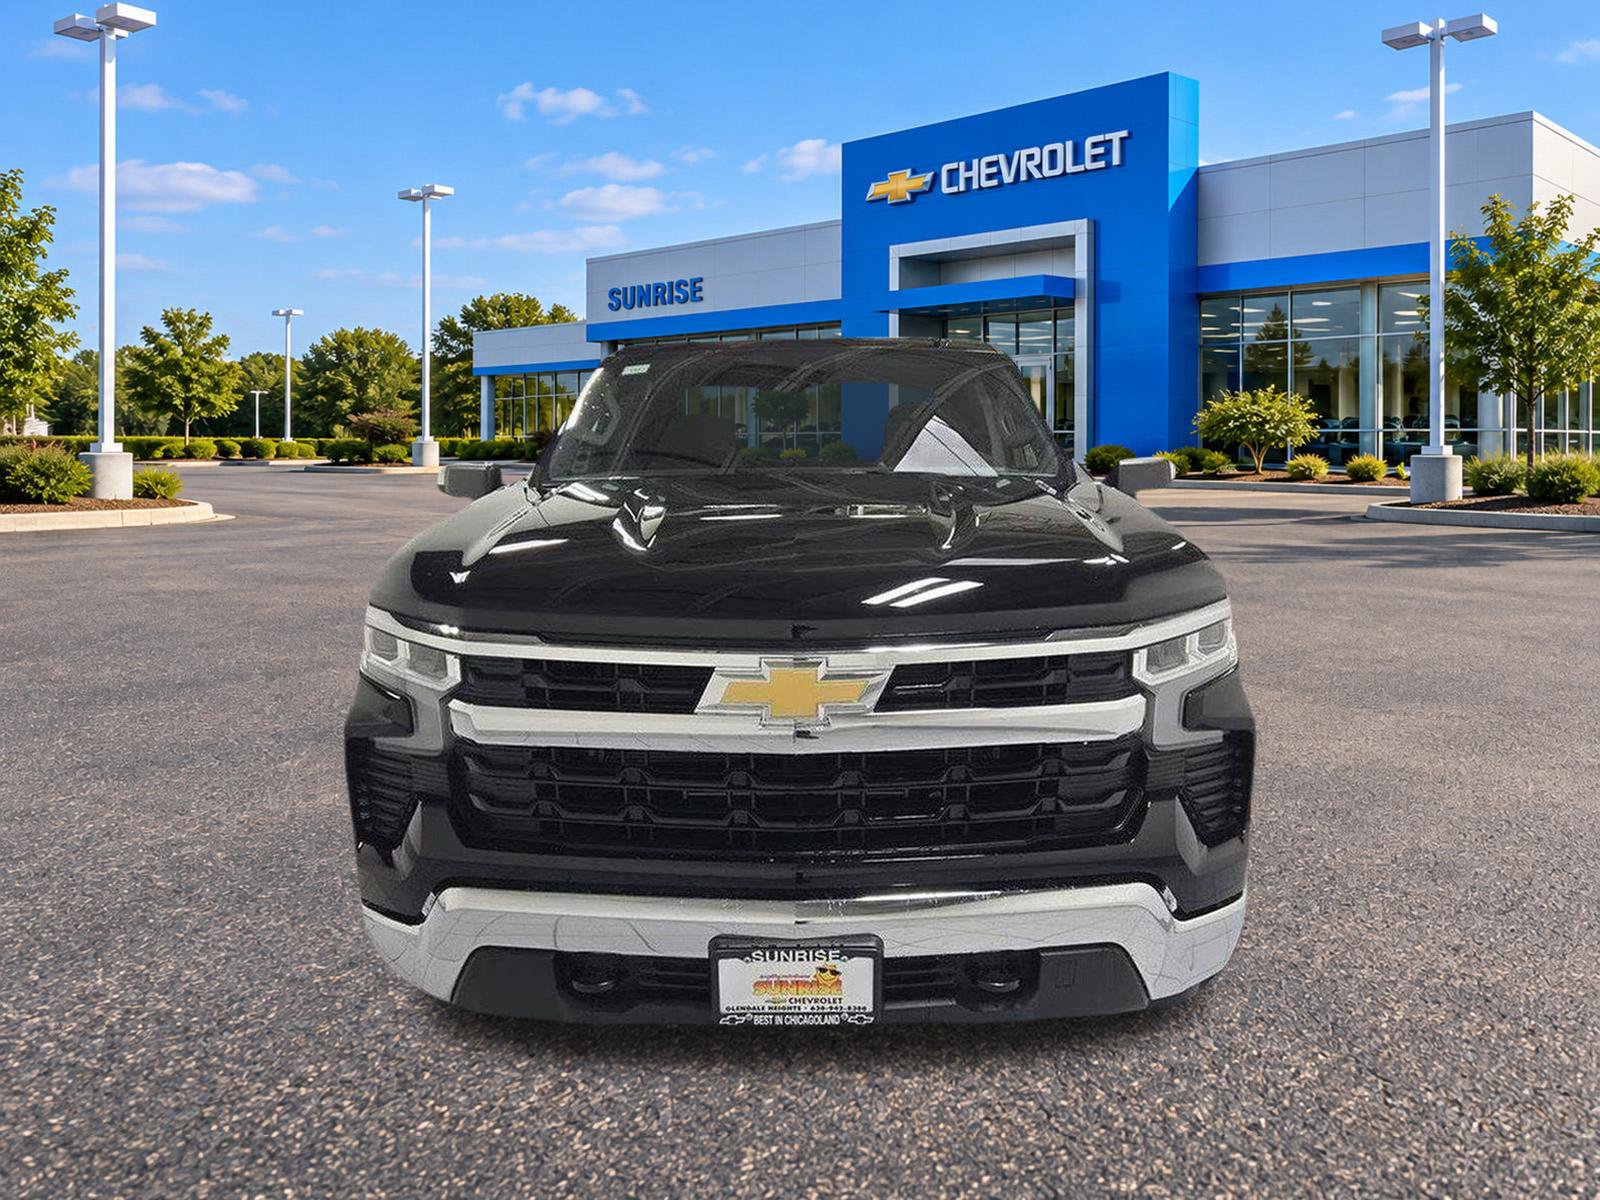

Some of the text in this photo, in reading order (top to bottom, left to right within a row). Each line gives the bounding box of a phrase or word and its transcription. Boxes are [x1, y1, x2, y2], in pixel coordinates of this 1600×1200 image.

[941, 130, 1129, 194] CHEVROLET
[607, 277, 704, 312] SUNRISE
[752, 950, 841, 962] SUNRISE
[788, 997, 843, 1005] CHEVROLET
[753, 1014, 840, 1025] BEST IN CHICAGOLAND
